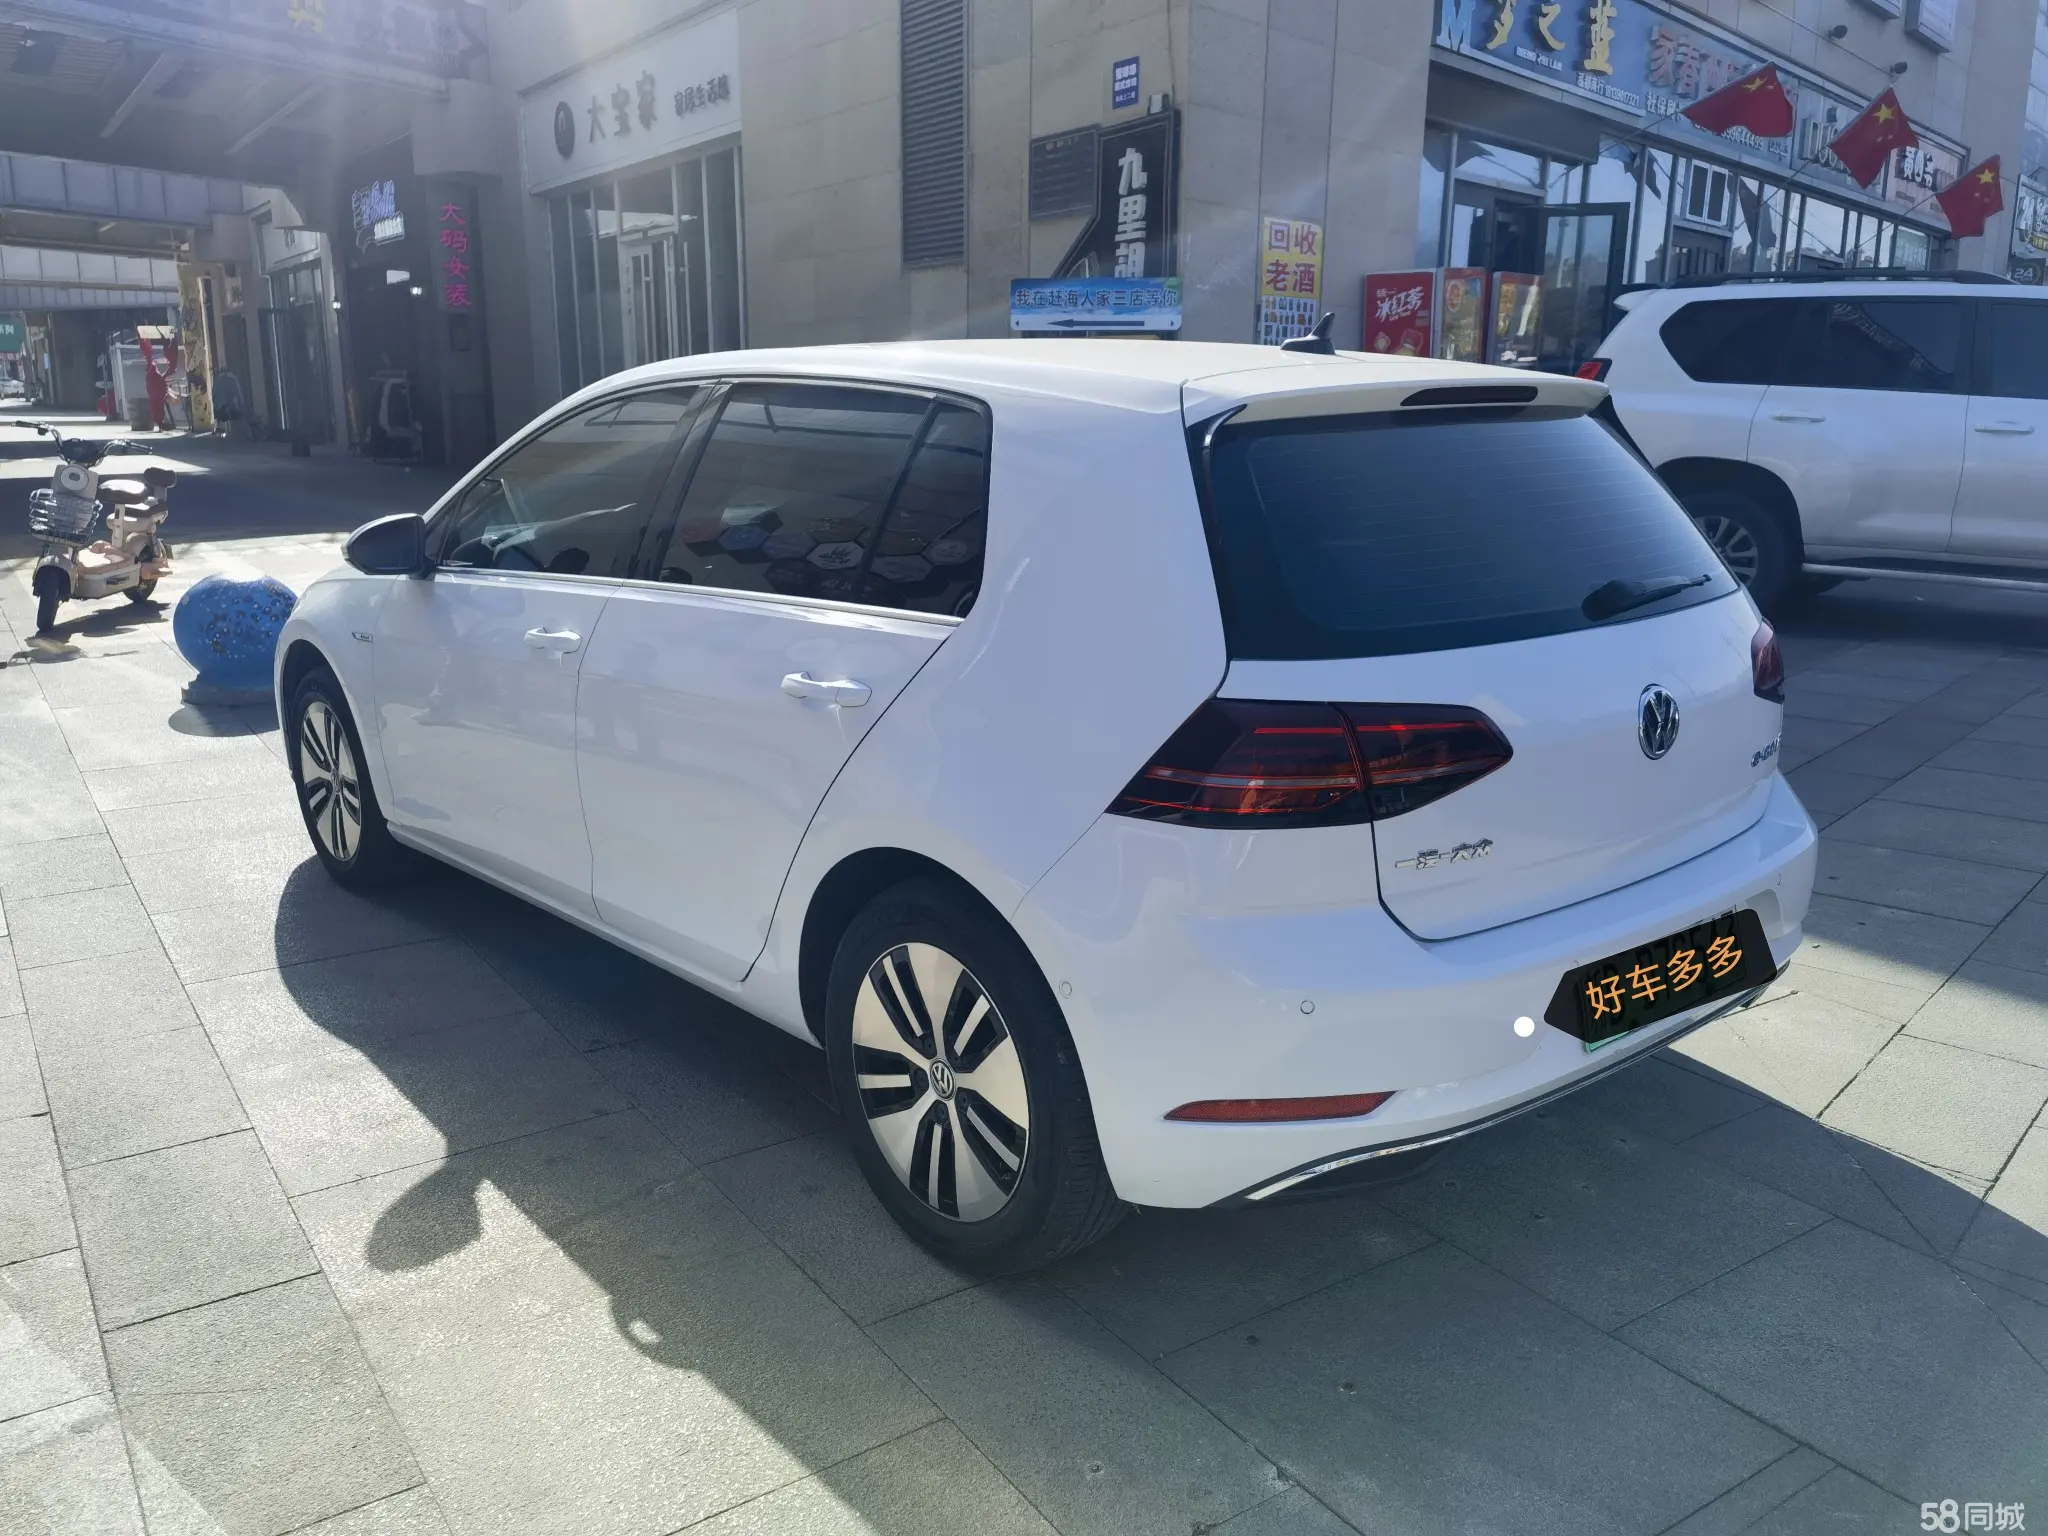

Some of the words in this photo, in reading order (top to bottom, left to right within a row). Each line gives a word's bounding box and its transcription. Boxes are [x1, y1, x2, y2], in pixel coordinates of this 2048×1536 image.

[439, 202, 471, 306] 大码女装
[1268, 221, 1318, 256] 回收
[1265, 258, 1316, 294] 老酒
[1016, 288, 1178, 308] 我在赶海人家三店等你
[1375, 286, 1425, 323] 冰红茶
